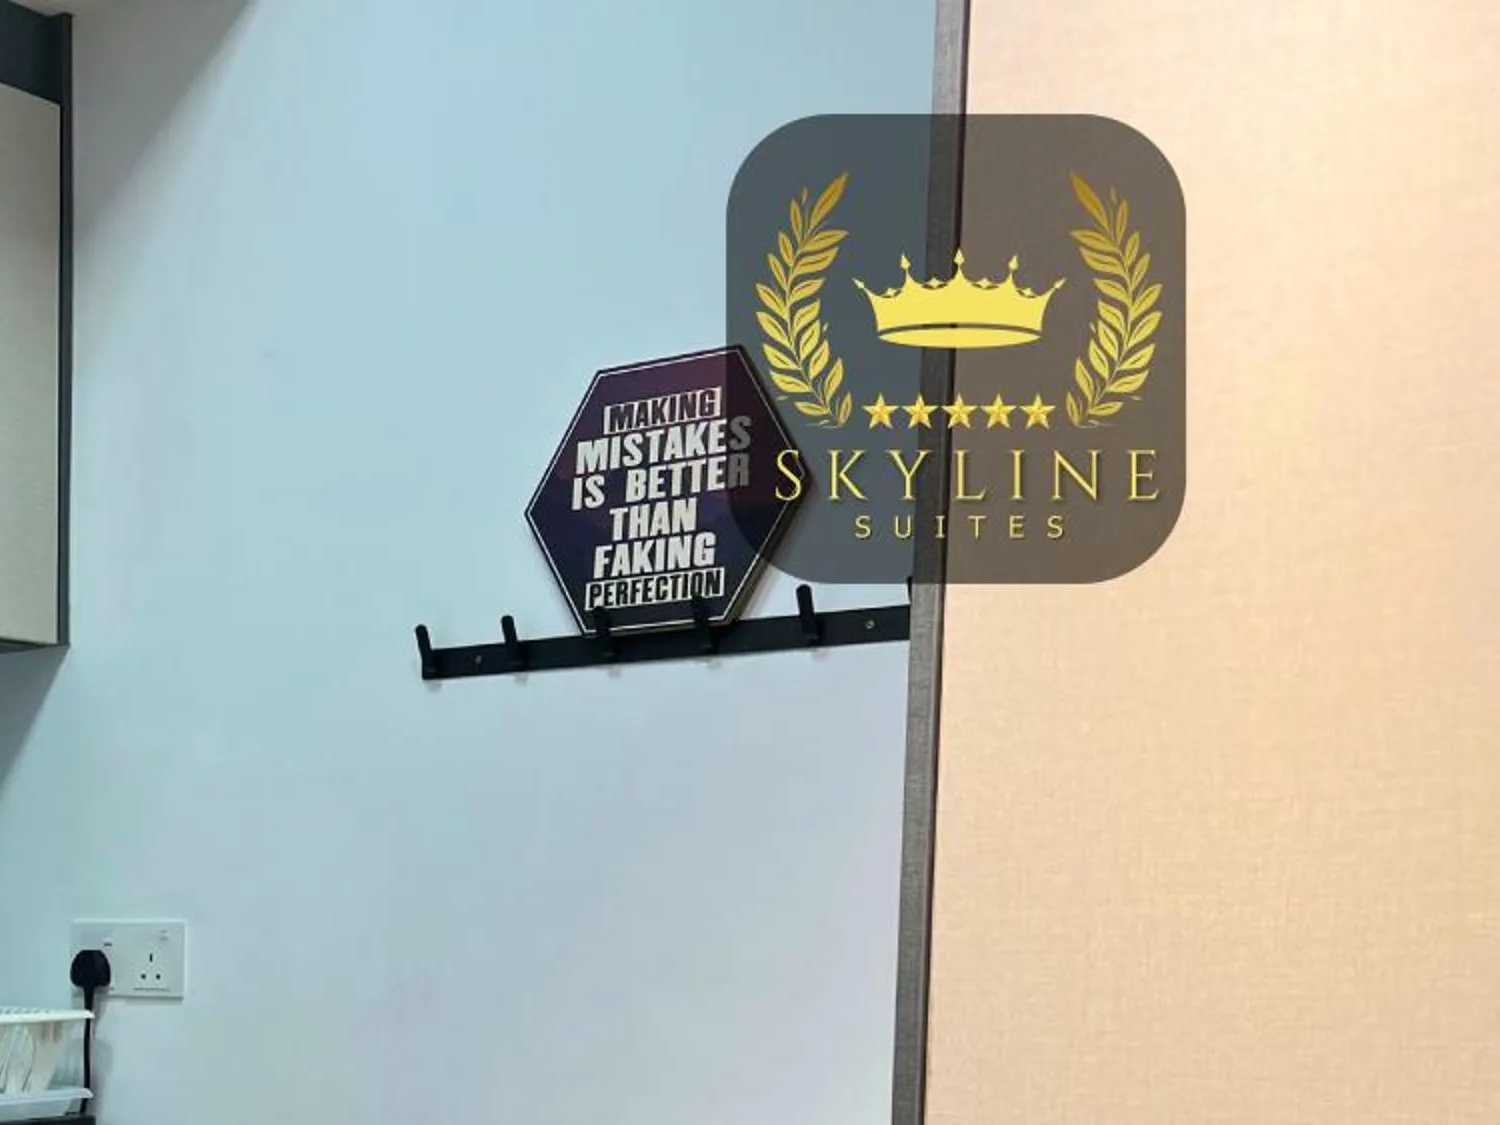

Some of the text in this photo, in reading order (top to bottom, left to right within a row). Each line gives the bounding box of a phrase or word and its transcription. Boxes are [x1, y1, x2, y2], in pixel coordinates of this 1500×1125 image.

[609, 389, 716, 431] MAKING
[577, 416, 751, 475] MISTAKES
[572, 453, 749, 512] IS BETTER
[610, 498, 698, 541] THAN
[594, 532, 717, 579] FAKING
[588, 569, 722, 610] PERFECTION
